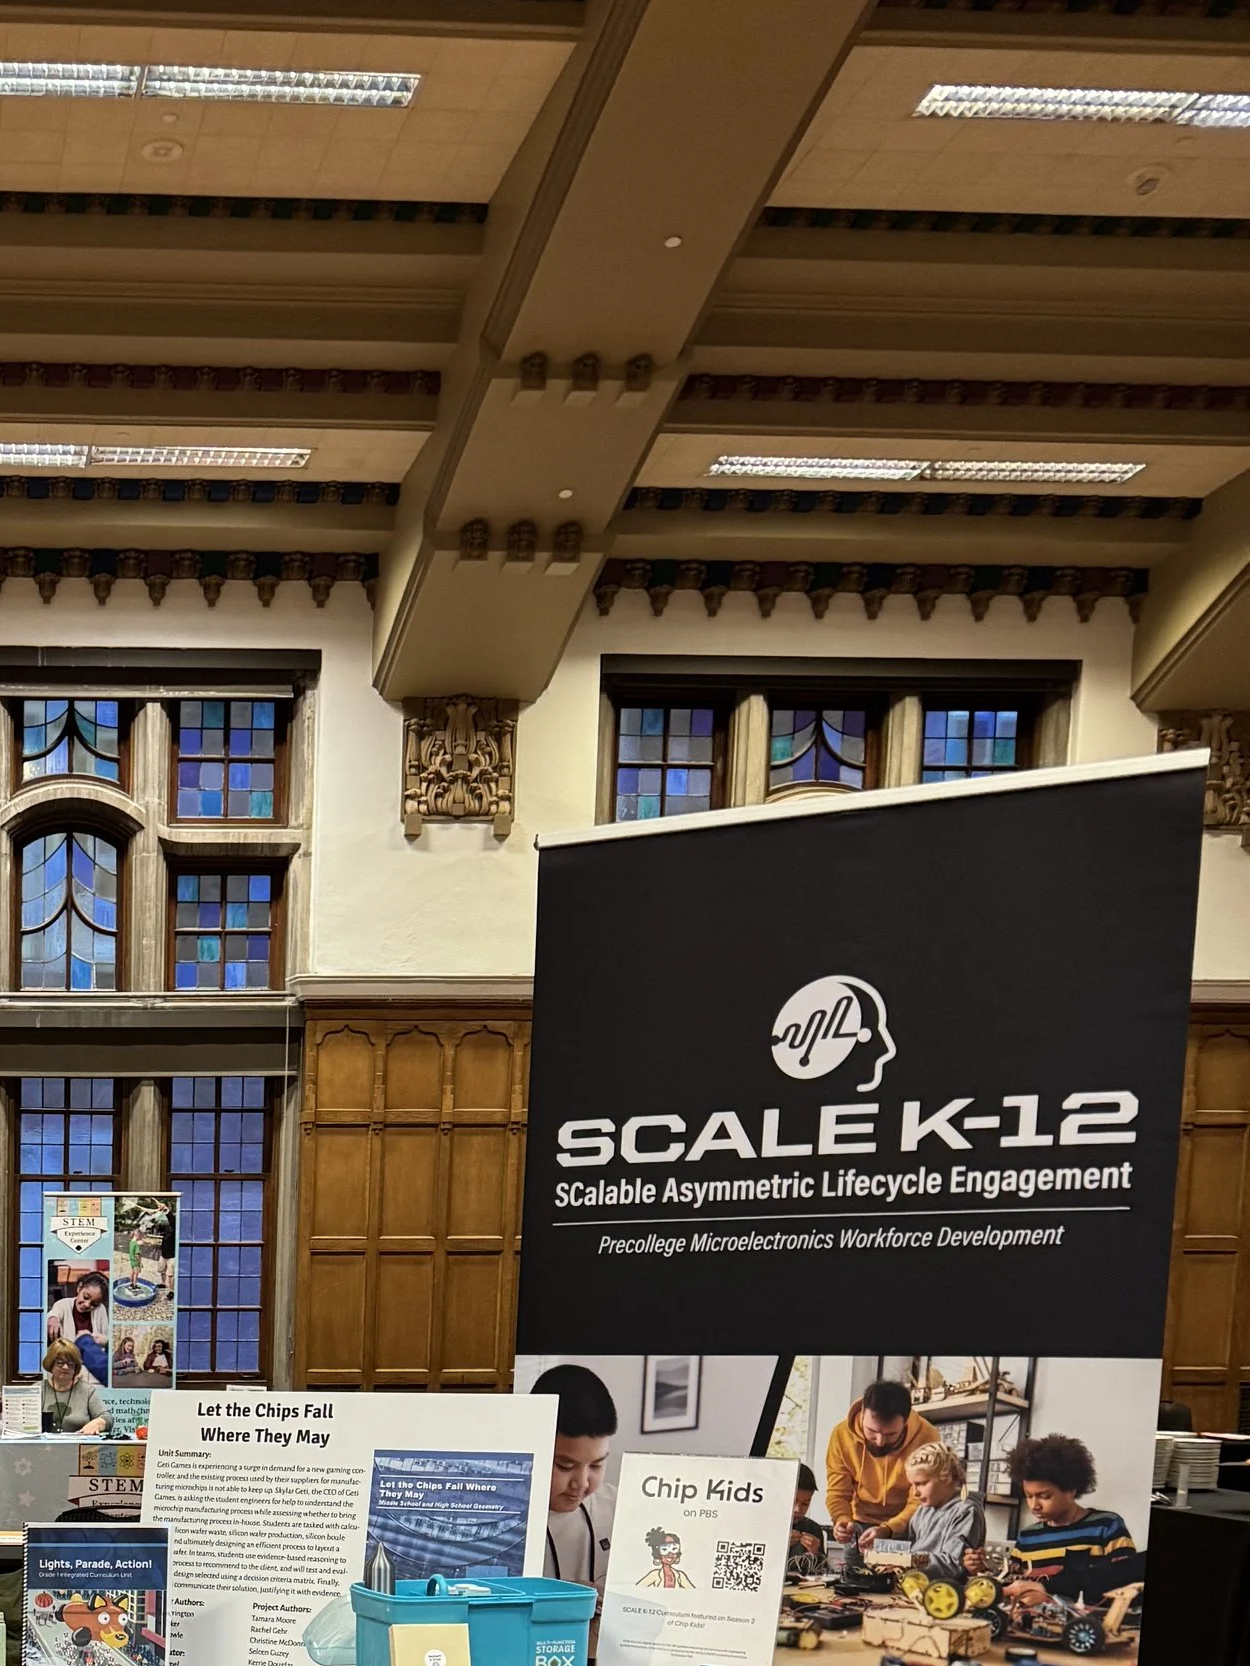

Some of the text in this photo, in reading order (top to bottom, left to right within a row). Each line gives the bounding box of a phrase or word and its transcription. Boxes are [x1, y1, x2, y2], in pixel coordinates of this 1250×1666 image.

[555, 1090, 1139, 1168] SCALE K-12
[555, 1162, 1133, 1209] SCalable Asymmetric Lifecycle Engagement
[63, 1218, 94, 1226] STEM
[597, 1225, 1065, 1257] Precollege Microelectronics Workforce Development
[197, 1402, 334, 1420] Let the Chips Fall
[201, 1427, 330, 1448] Where They May
[89, 1478, 143, 1492] STEM
[642, 1476, 764, 1504] Chip Kids
[683, 1509, 718, 1519] on PBS
[39, 1560, 152, 1569] Lights, Parade, Action!
[252, 1602, 312, 1614] Project Authors:
[657, 1609, 690, 1618] Curriculum
[675, 1620, 688, 1628] Chip
[689, 1621, 705, 1629] Kids!
[536, 1645, 575, 1653] STORAGE
